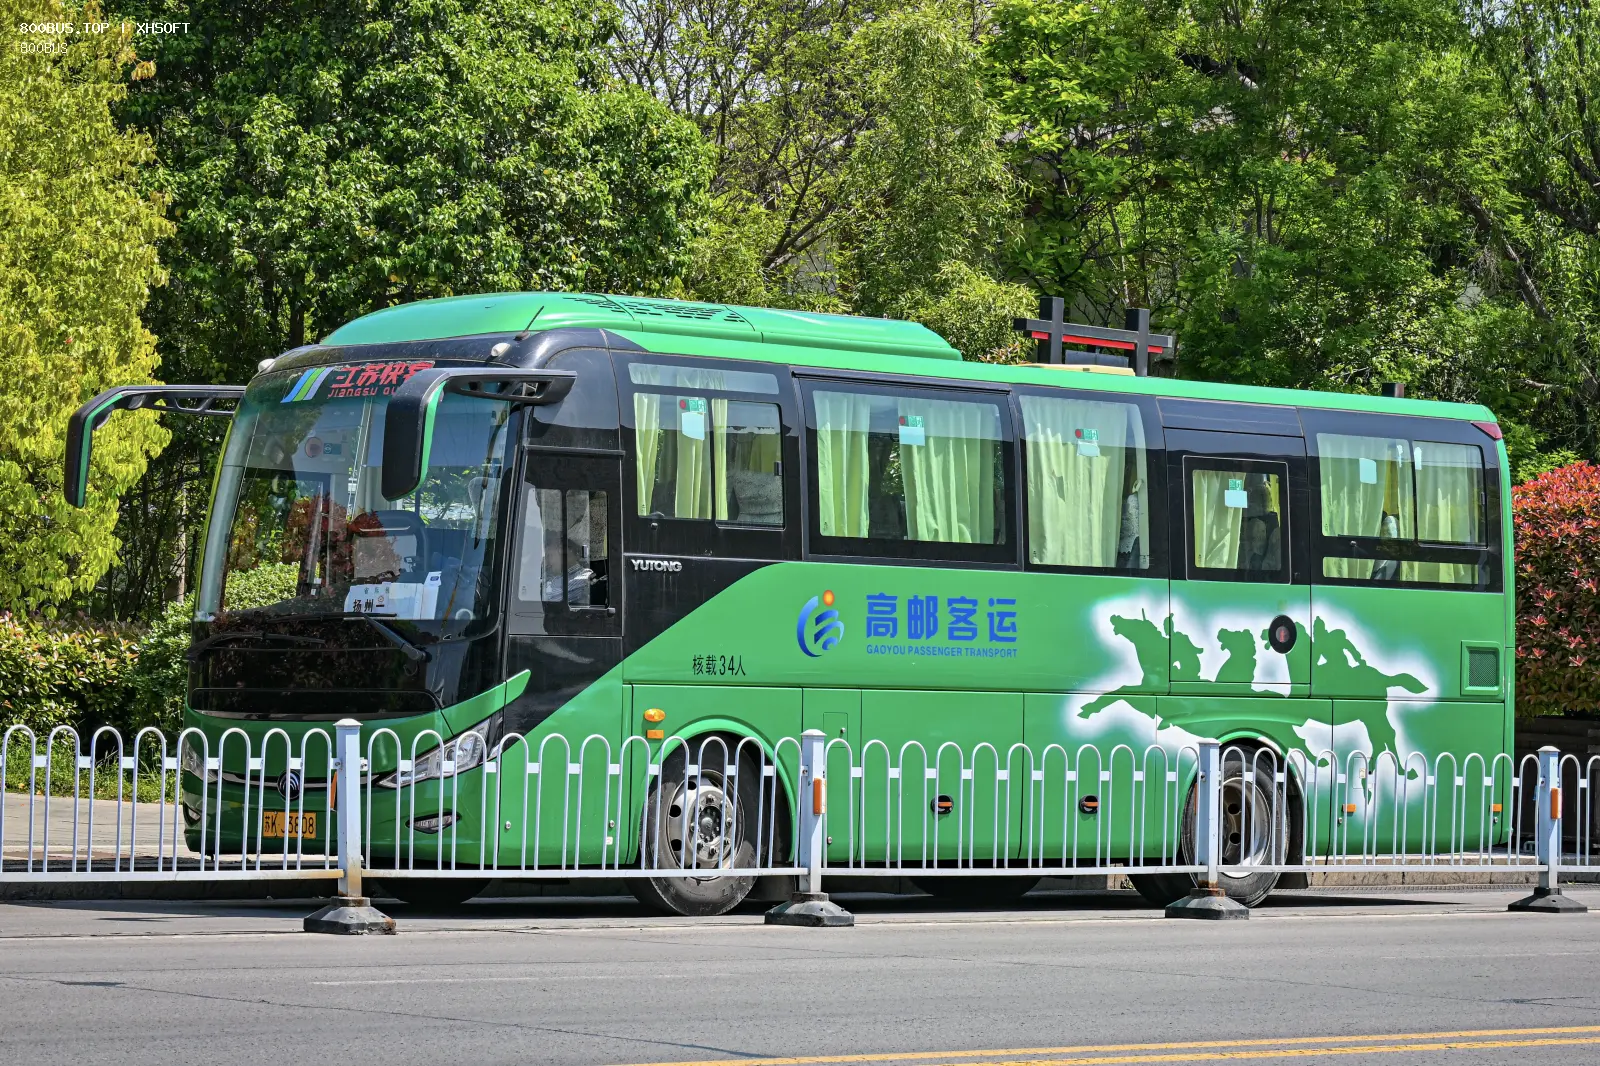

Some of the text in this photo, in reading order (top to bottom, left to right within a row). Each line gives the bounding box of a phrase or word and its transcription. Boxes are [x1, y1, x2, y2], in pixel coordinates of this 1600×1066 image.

[631, 559, 682, 572] YUTONG
[866, 592, 1018, 643] 高邮客运
[866, 644, 1018, 658] GAOYOU PASSENGER TRANSPORT
[692, 654, 746, 676] 核载34人
